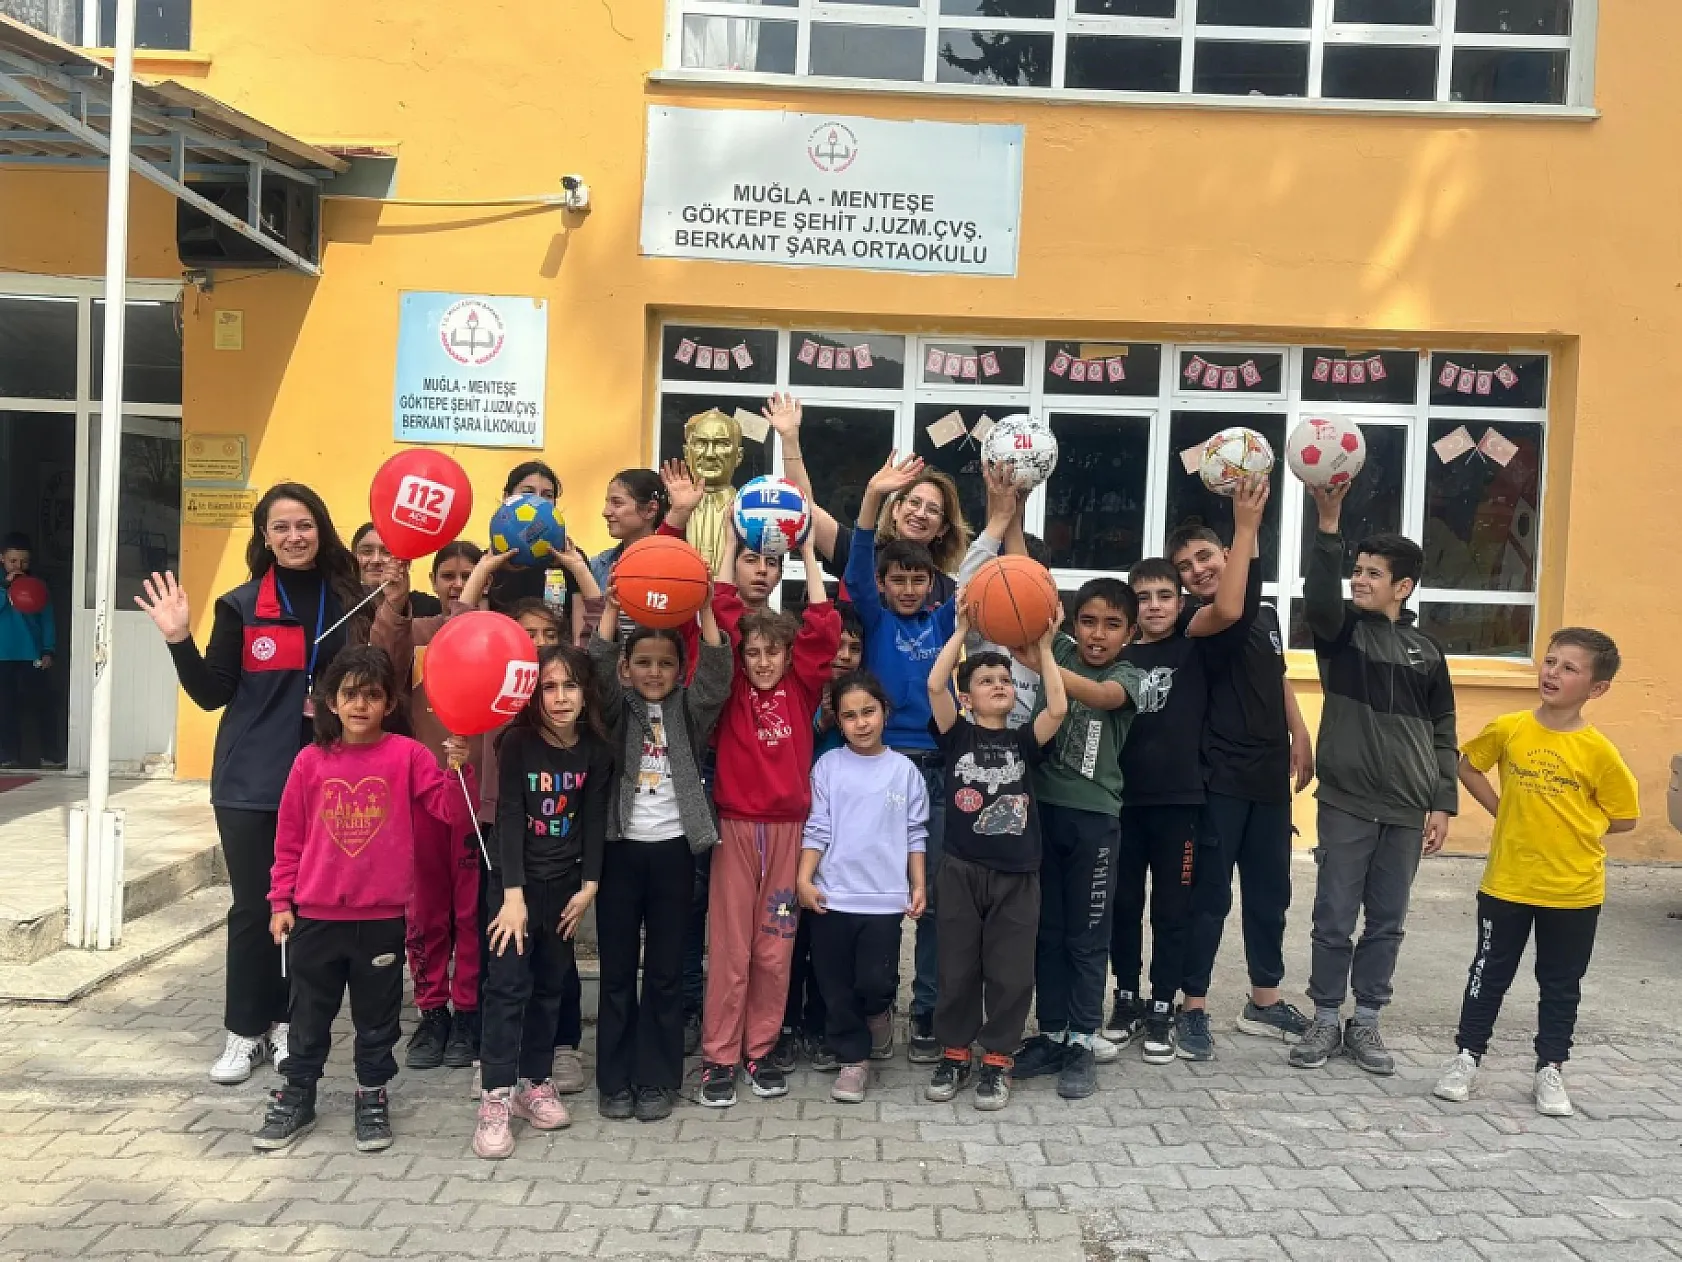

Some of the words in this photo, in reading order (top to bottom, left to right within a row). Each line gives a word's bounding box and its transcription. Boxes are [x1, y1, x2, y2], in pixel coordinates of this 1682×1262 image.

[733, 182, 812, 205] MUĞLA
[831, 189, 934, 215] MENTEŞE
[682, 202, 787, 227] GÖKTEPE
[793, 209, 857, 233] ŞEHİT
[862, 216, 982, 243] J.UZM.ÇVŞ.
[675, 229, 780, 252] BERKANT
[786, 235, 847, 258] ŞARA
[852, 240, 988, 264] ORTAOKULU
[423, 375, 460, 392] MUĞLA
[468, 379, 517, 397] MENTEŞE
[399, 394, 448, 410] GÖKTEPE
[451, 396, 480, 414] ŞEHİT
[403, 414, 451, 429] BERKANT
[453, 416, 482, 434] ŞARA
[483, 416, 536, 434] İLKOKULU
[1014, 434, 1033, 450] 112
[408, 483, 446, 514] 112
[760, 489, 781, 505] 112
[646, 591, 669, 610] 112
[1181, 840, 1193, 886] STREET
